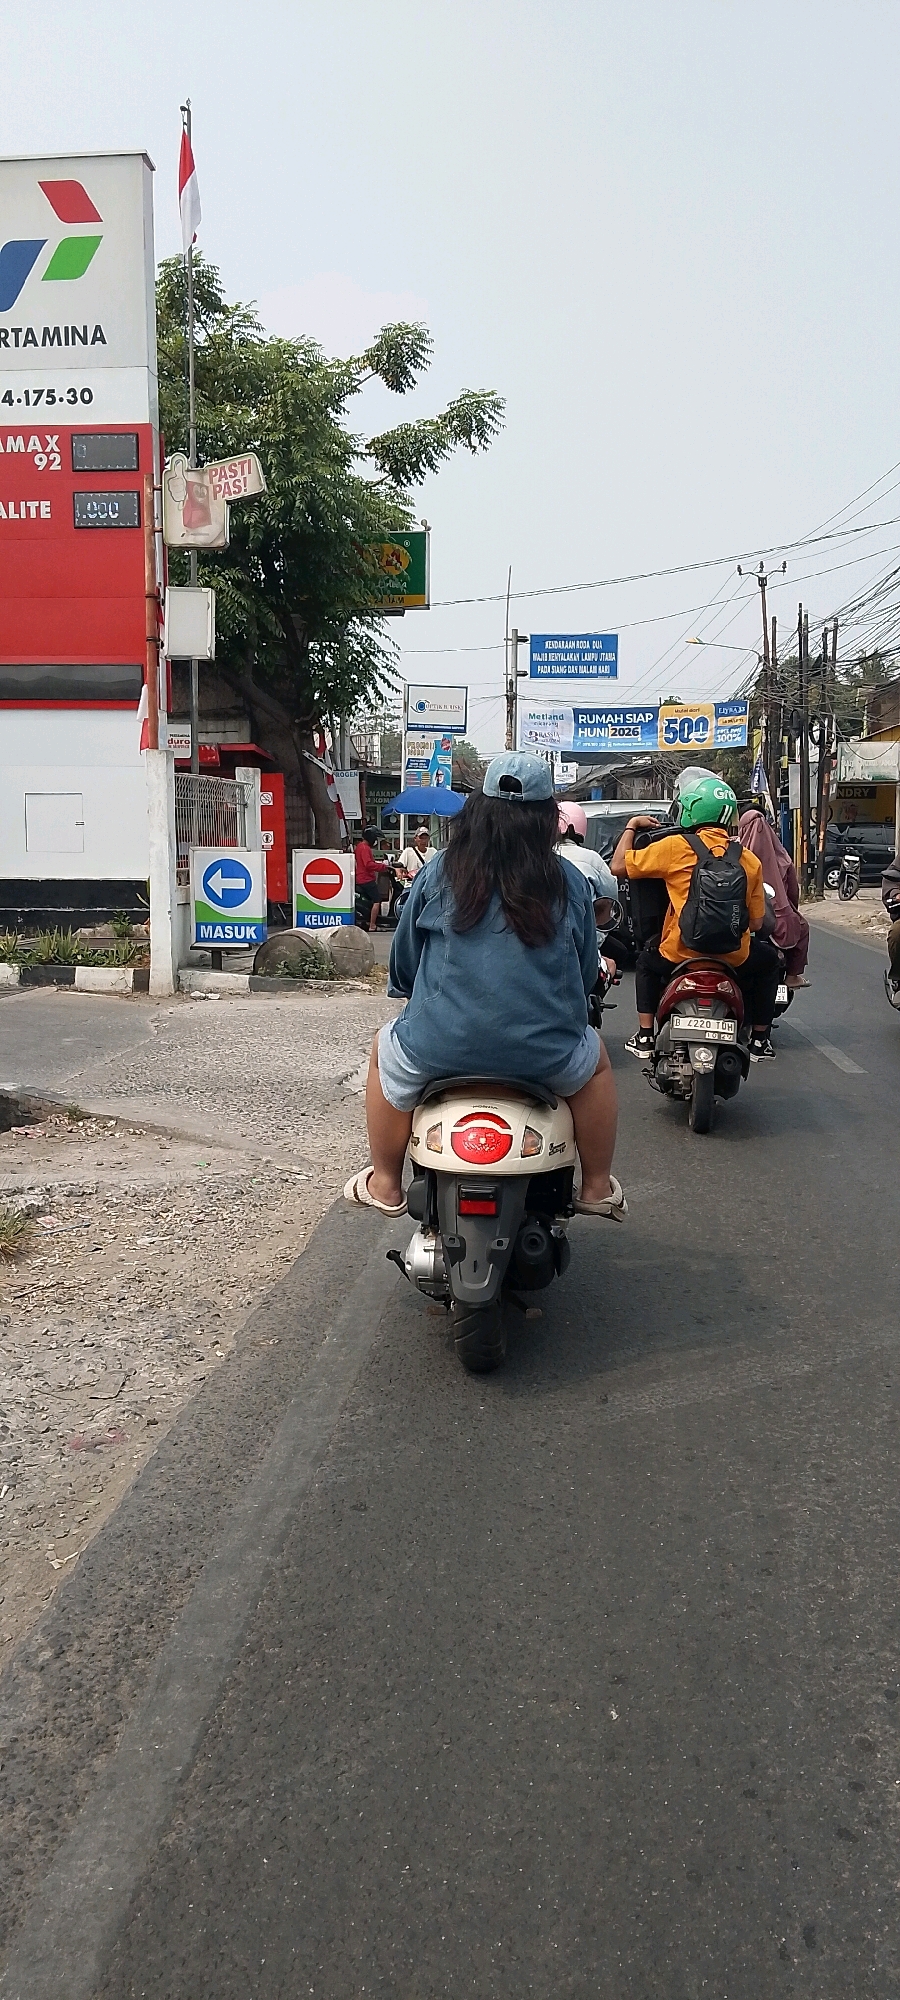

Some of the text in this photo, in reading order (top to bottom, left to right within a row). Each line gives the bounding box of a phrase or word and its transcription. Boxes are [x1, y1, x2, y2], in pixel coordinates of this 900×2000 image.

[34, 453, 61, 470] 92
[208, 459, 252, 484] PASTI
[212, 477, 248, 500] PAS!
[578, 713, 654, 724] RUMAH SIAP
[578, 727, 640, 738] HUNI 2026
[663, 716, 710, 745] 500
[304, 915, 342, 926] KELUAR
[200, 925, 257, 940] MASUK
[675, 1018, 681, 1027] B
